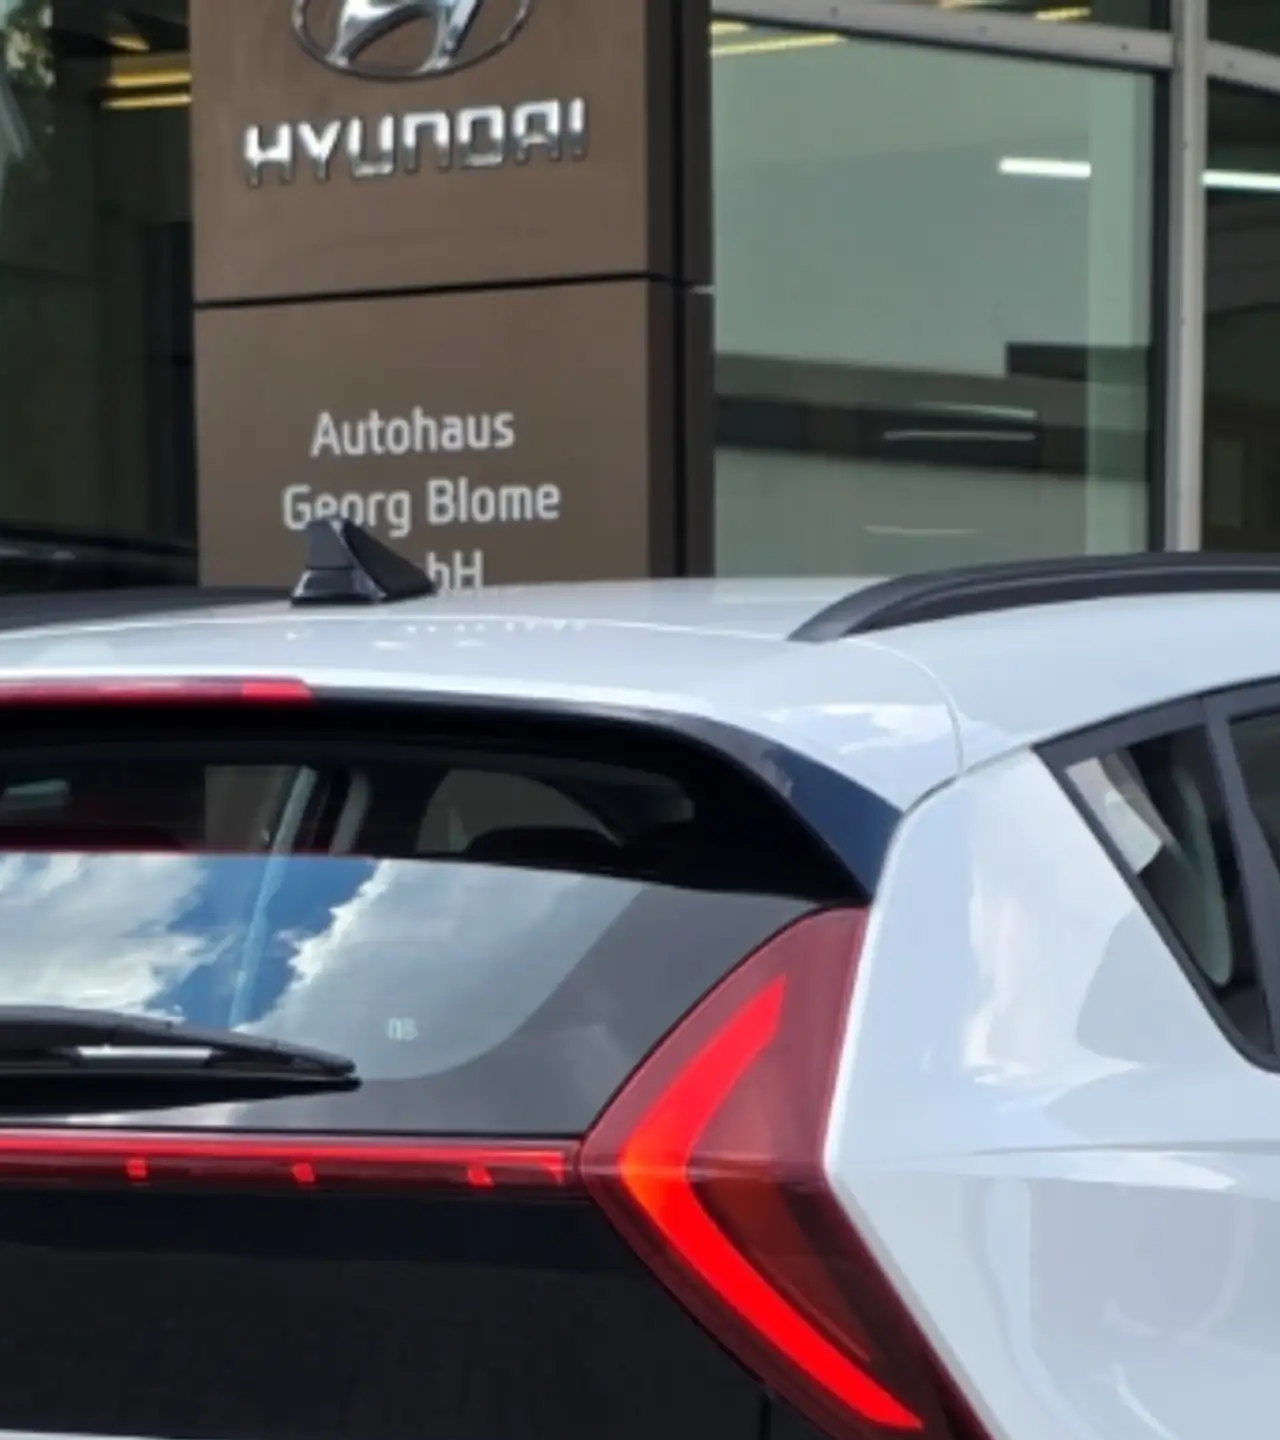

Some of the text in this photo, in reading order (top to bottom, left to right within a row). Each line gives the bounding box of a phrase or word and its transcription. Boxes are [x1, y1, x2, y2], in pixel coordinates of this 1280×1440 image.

[243, 97, 586, 187] HYUNDAI
[309, 405, 516, 458] Autohaus
[282, 475, 561, 538] Georg Blome
